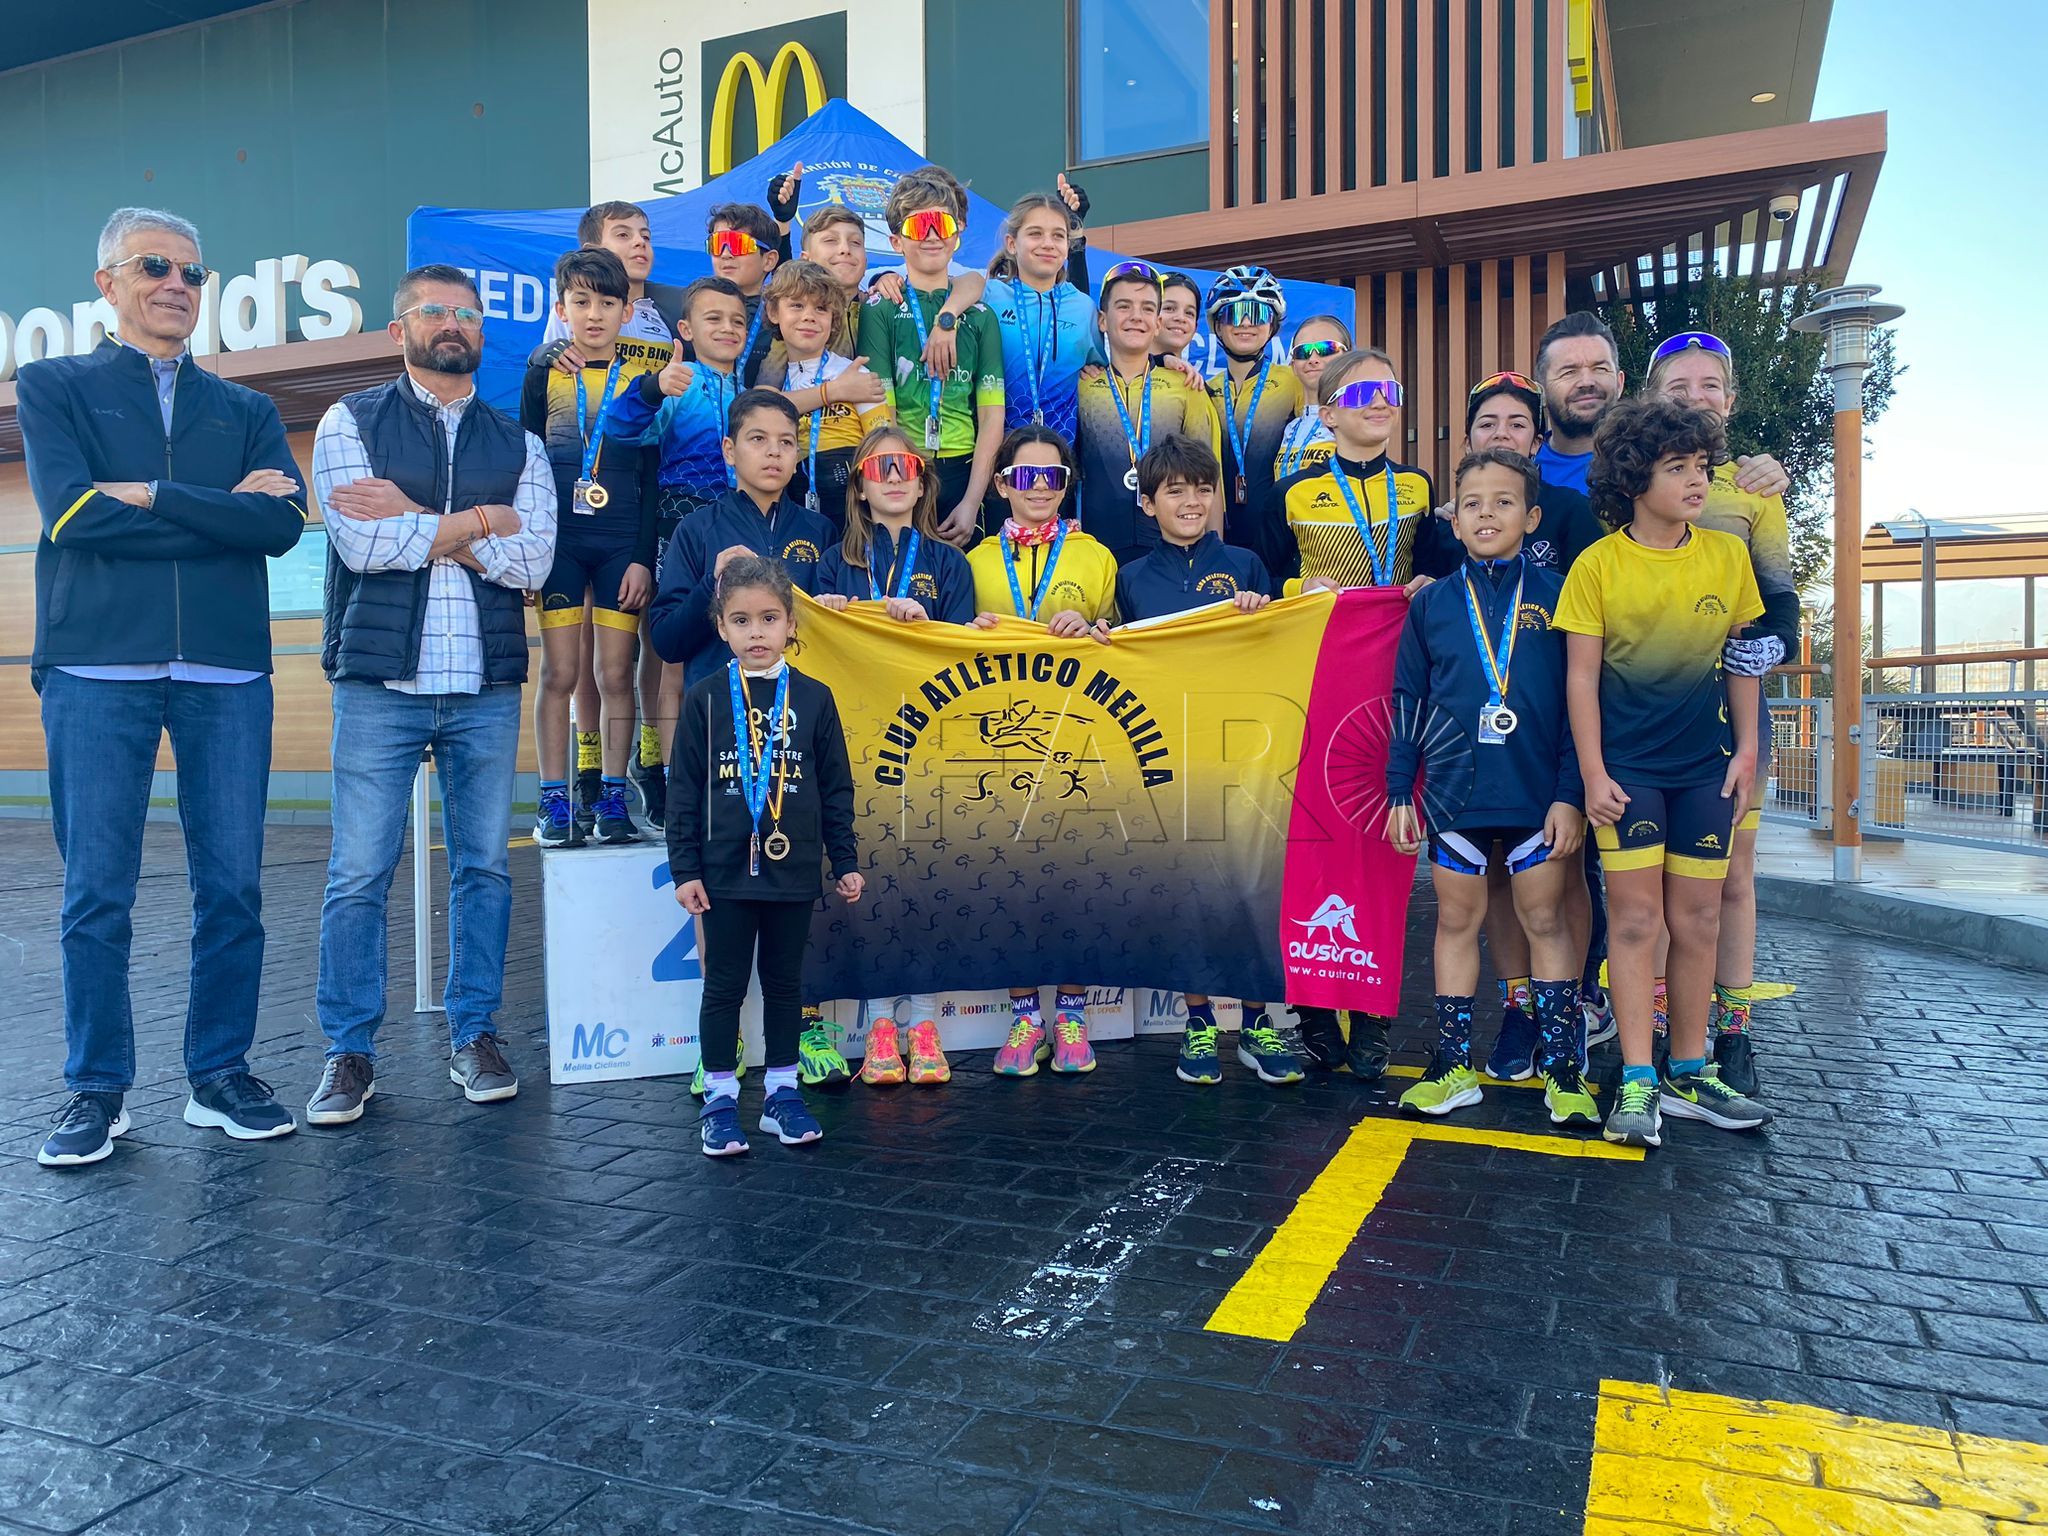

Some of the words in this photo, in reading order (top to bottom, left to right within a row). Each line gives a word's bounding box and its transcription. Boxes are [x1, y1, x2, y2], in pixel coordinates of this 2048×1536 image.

[647, 346, 674, 363] BIKE
[873, 702, 931, 788] CLUB
[919, 651, 1082, 713] ATLÉTICO
[1082, 669, 1175, 790] MELILLA
[1288, 941, 1379, 969] austral
[960, 1003, 997, 1015] RODBE
[562, 1061, 593, 1072] Melilla
[594, 1060, 631, 1070] Ciclismo
